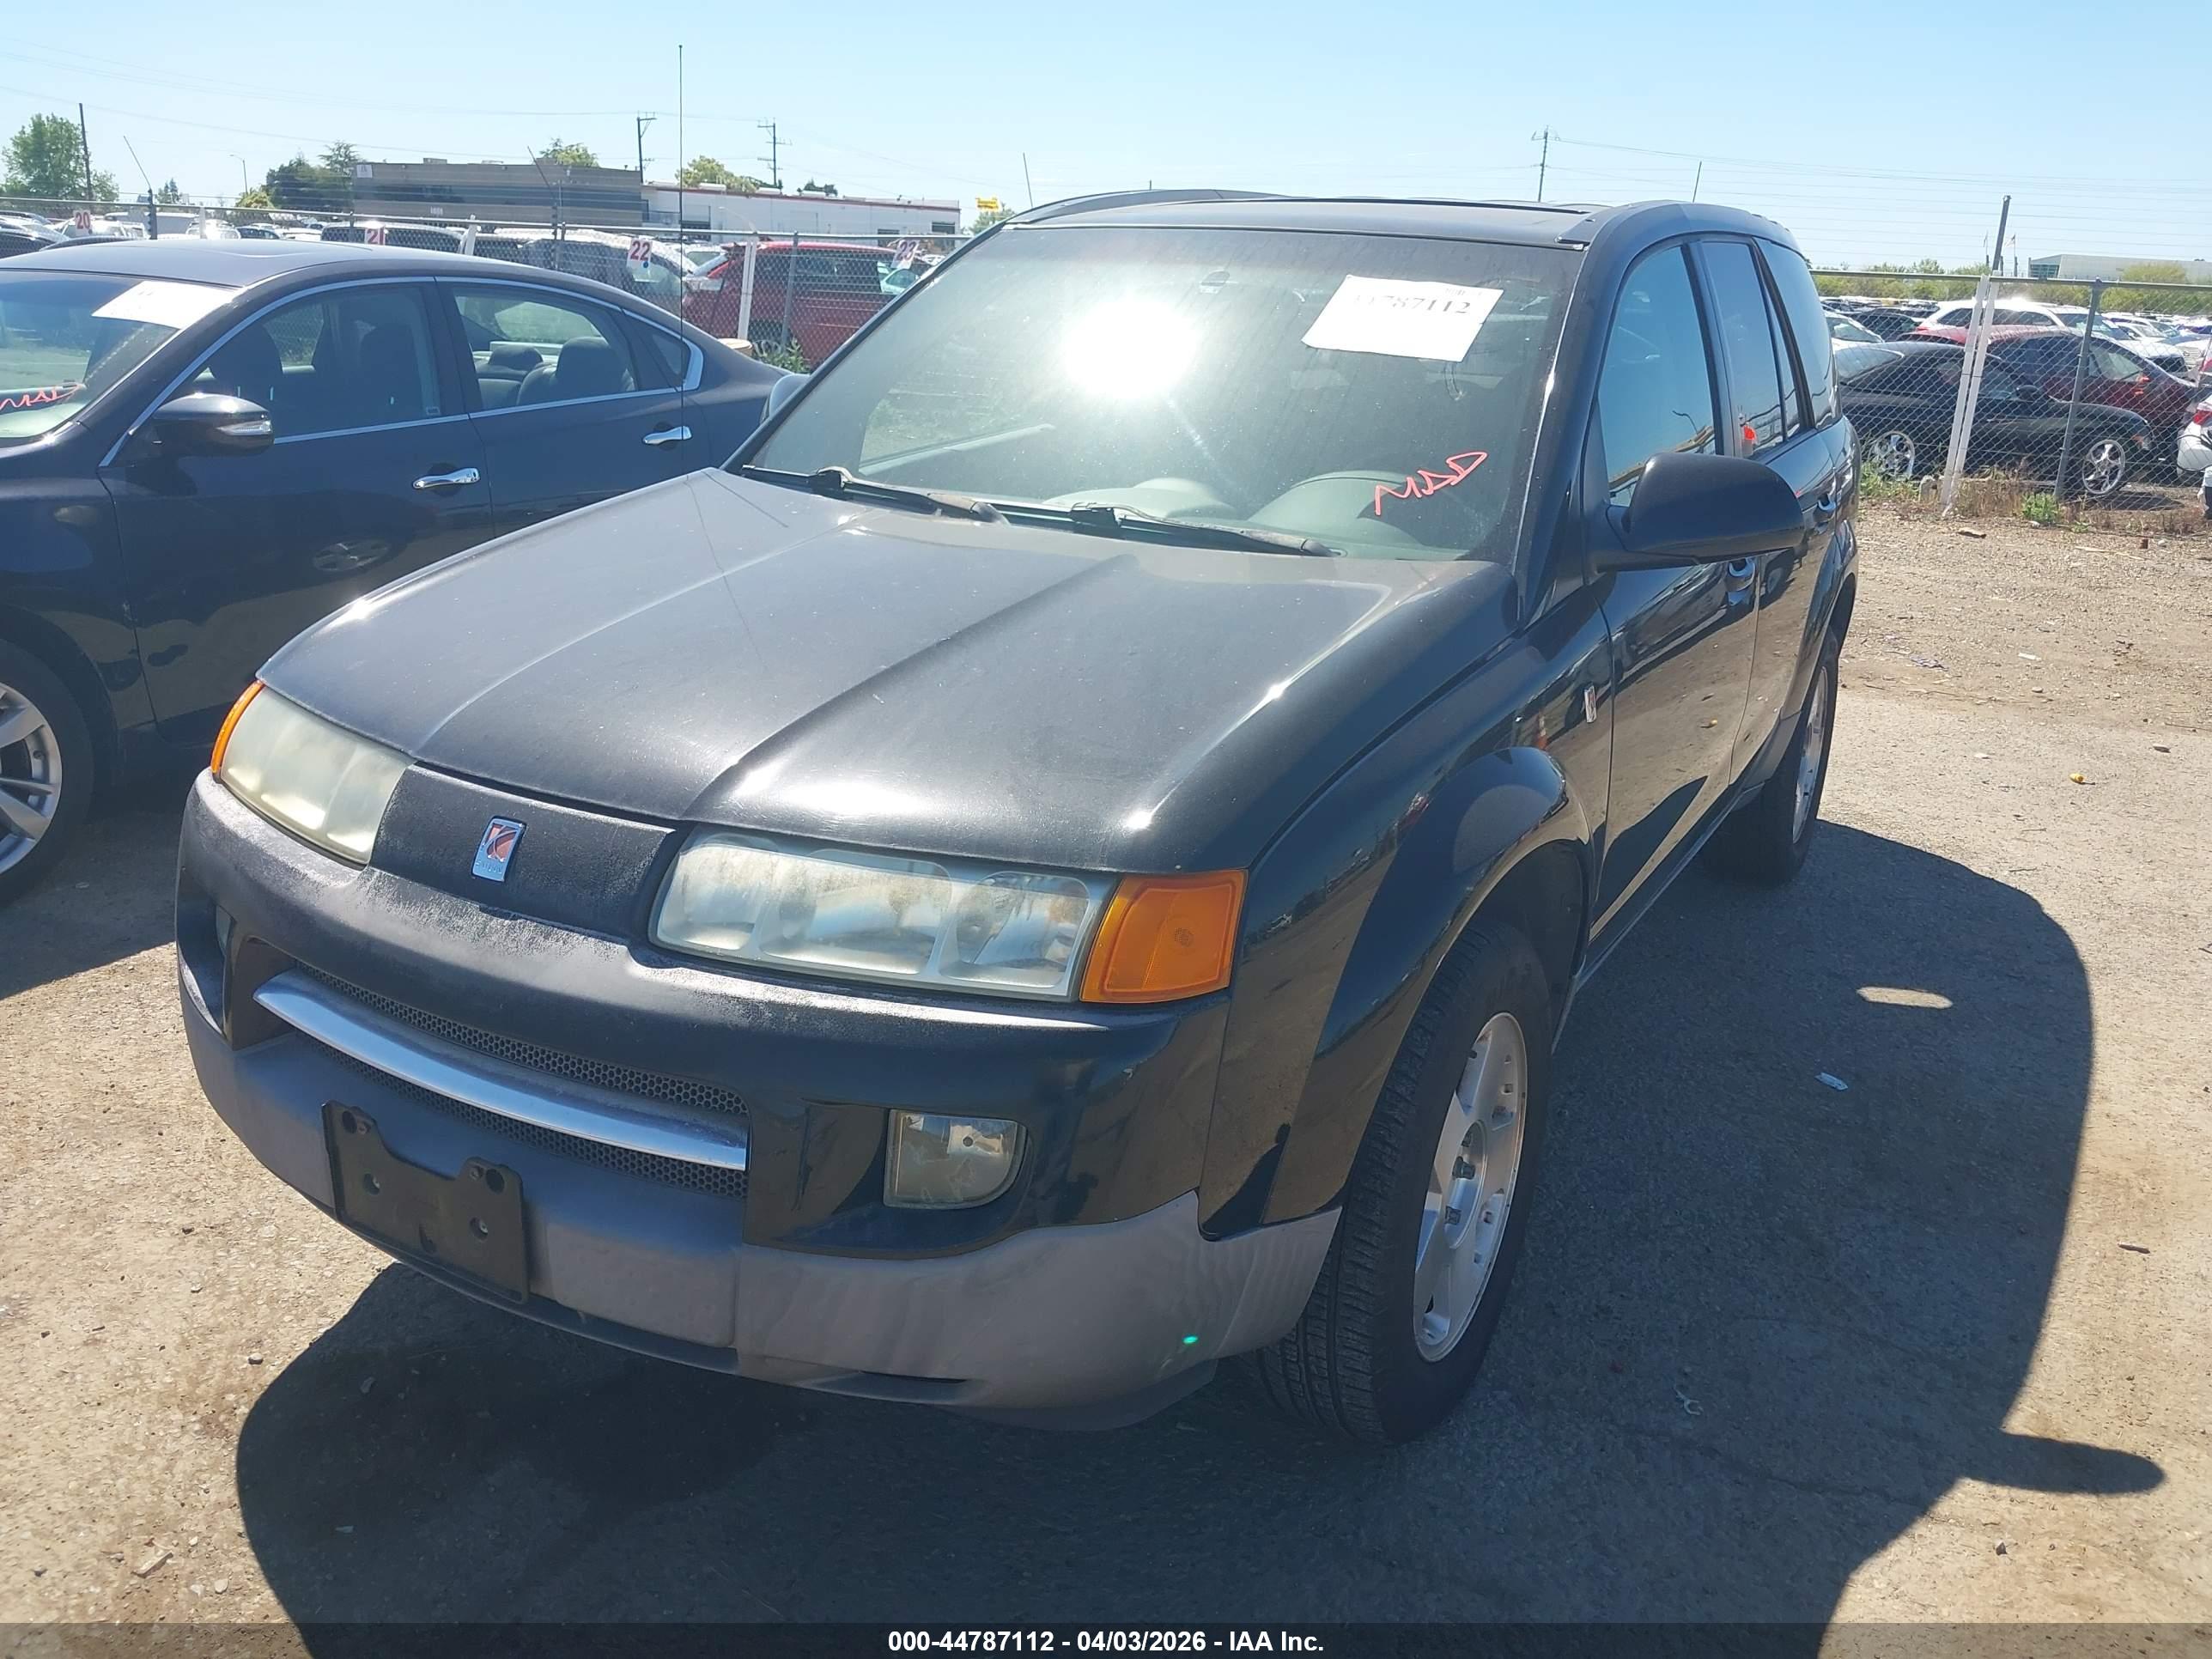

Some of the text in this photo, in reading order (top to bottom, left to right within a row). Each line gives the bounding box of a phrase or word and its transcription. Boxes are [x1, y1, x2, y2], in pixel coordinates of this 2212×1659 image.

[76, 211, 90, 229] 20
[366, 228, 384, 245] 21
[630, 240, 650, 261] 22
[896, 241, 916, 261] 23
[1353, 295, 1471, 314] 787112
[1375, 451, 1488, 516] MAD
